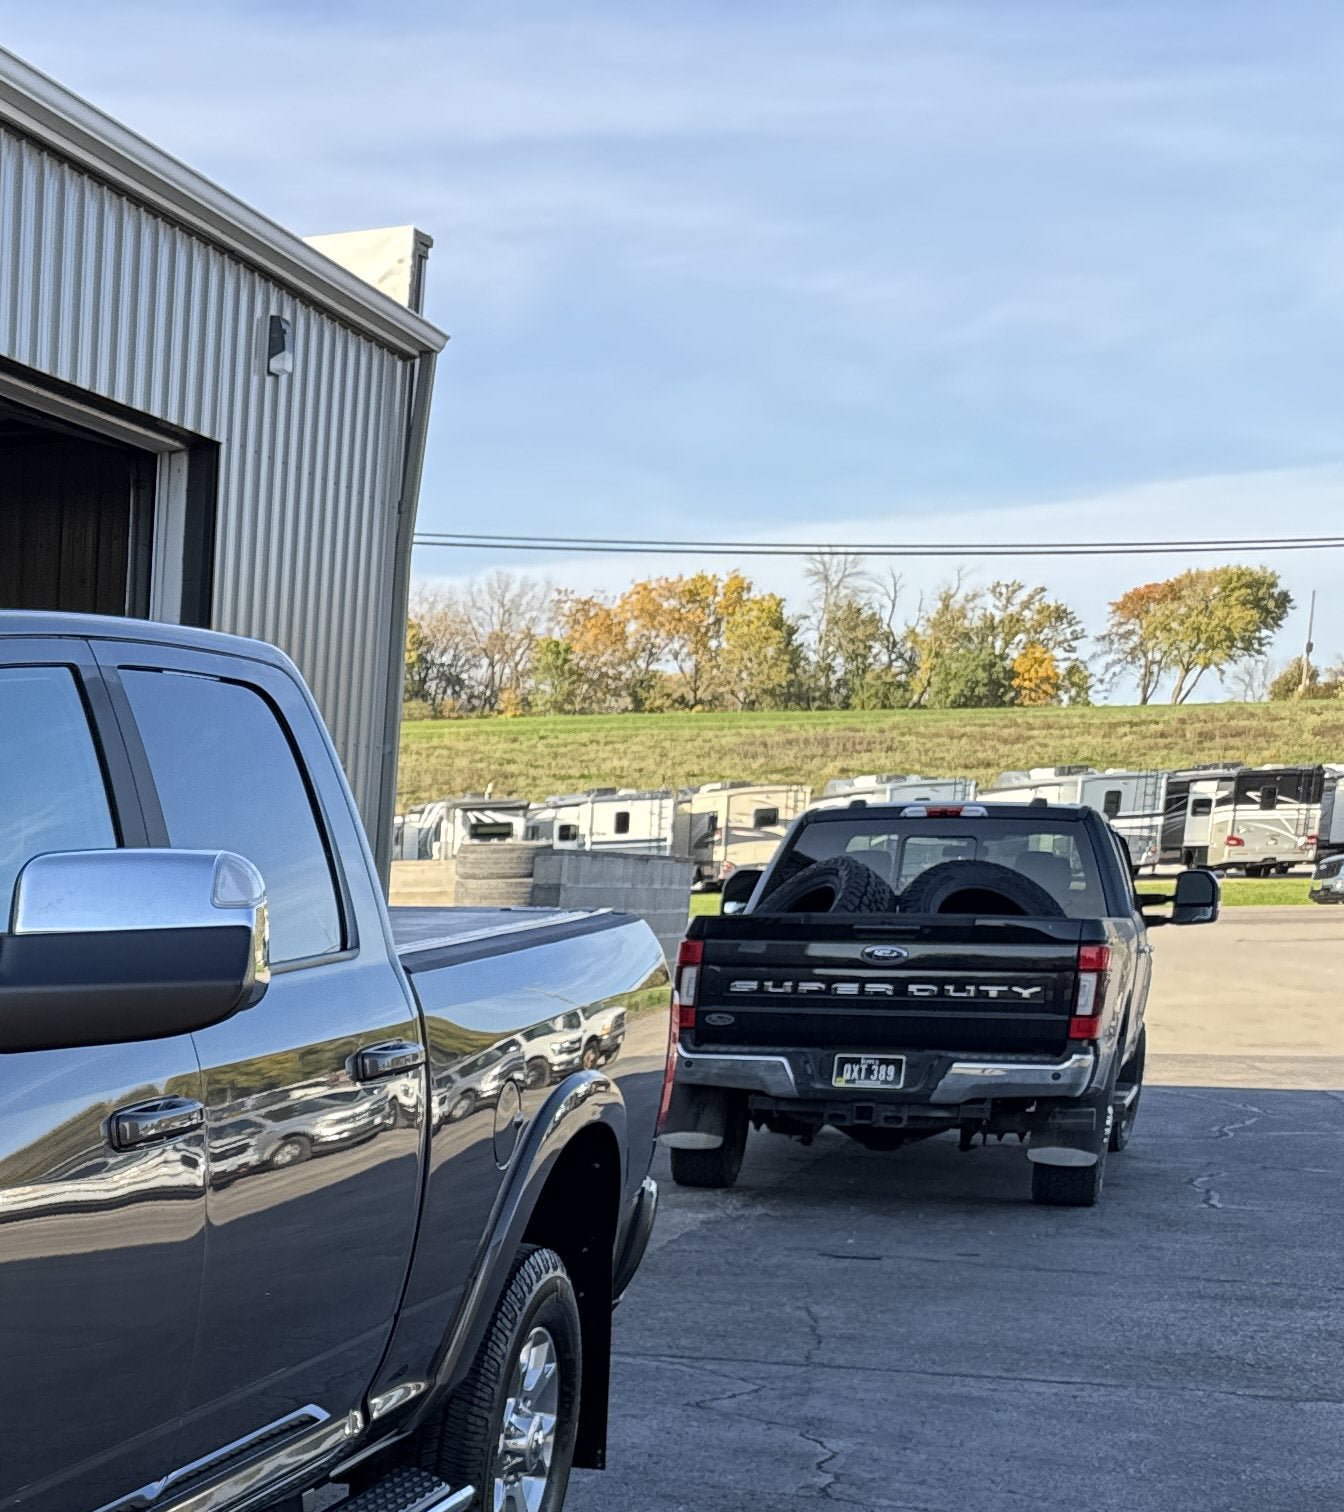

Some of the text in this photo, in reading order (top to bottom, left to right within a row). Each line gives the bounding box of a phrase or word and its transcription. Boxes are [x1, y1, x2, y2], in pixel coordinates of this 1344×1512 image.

[729, 980, 1042, 999] SUPER DUTY
[870, 1064, 896, 1082] 389
